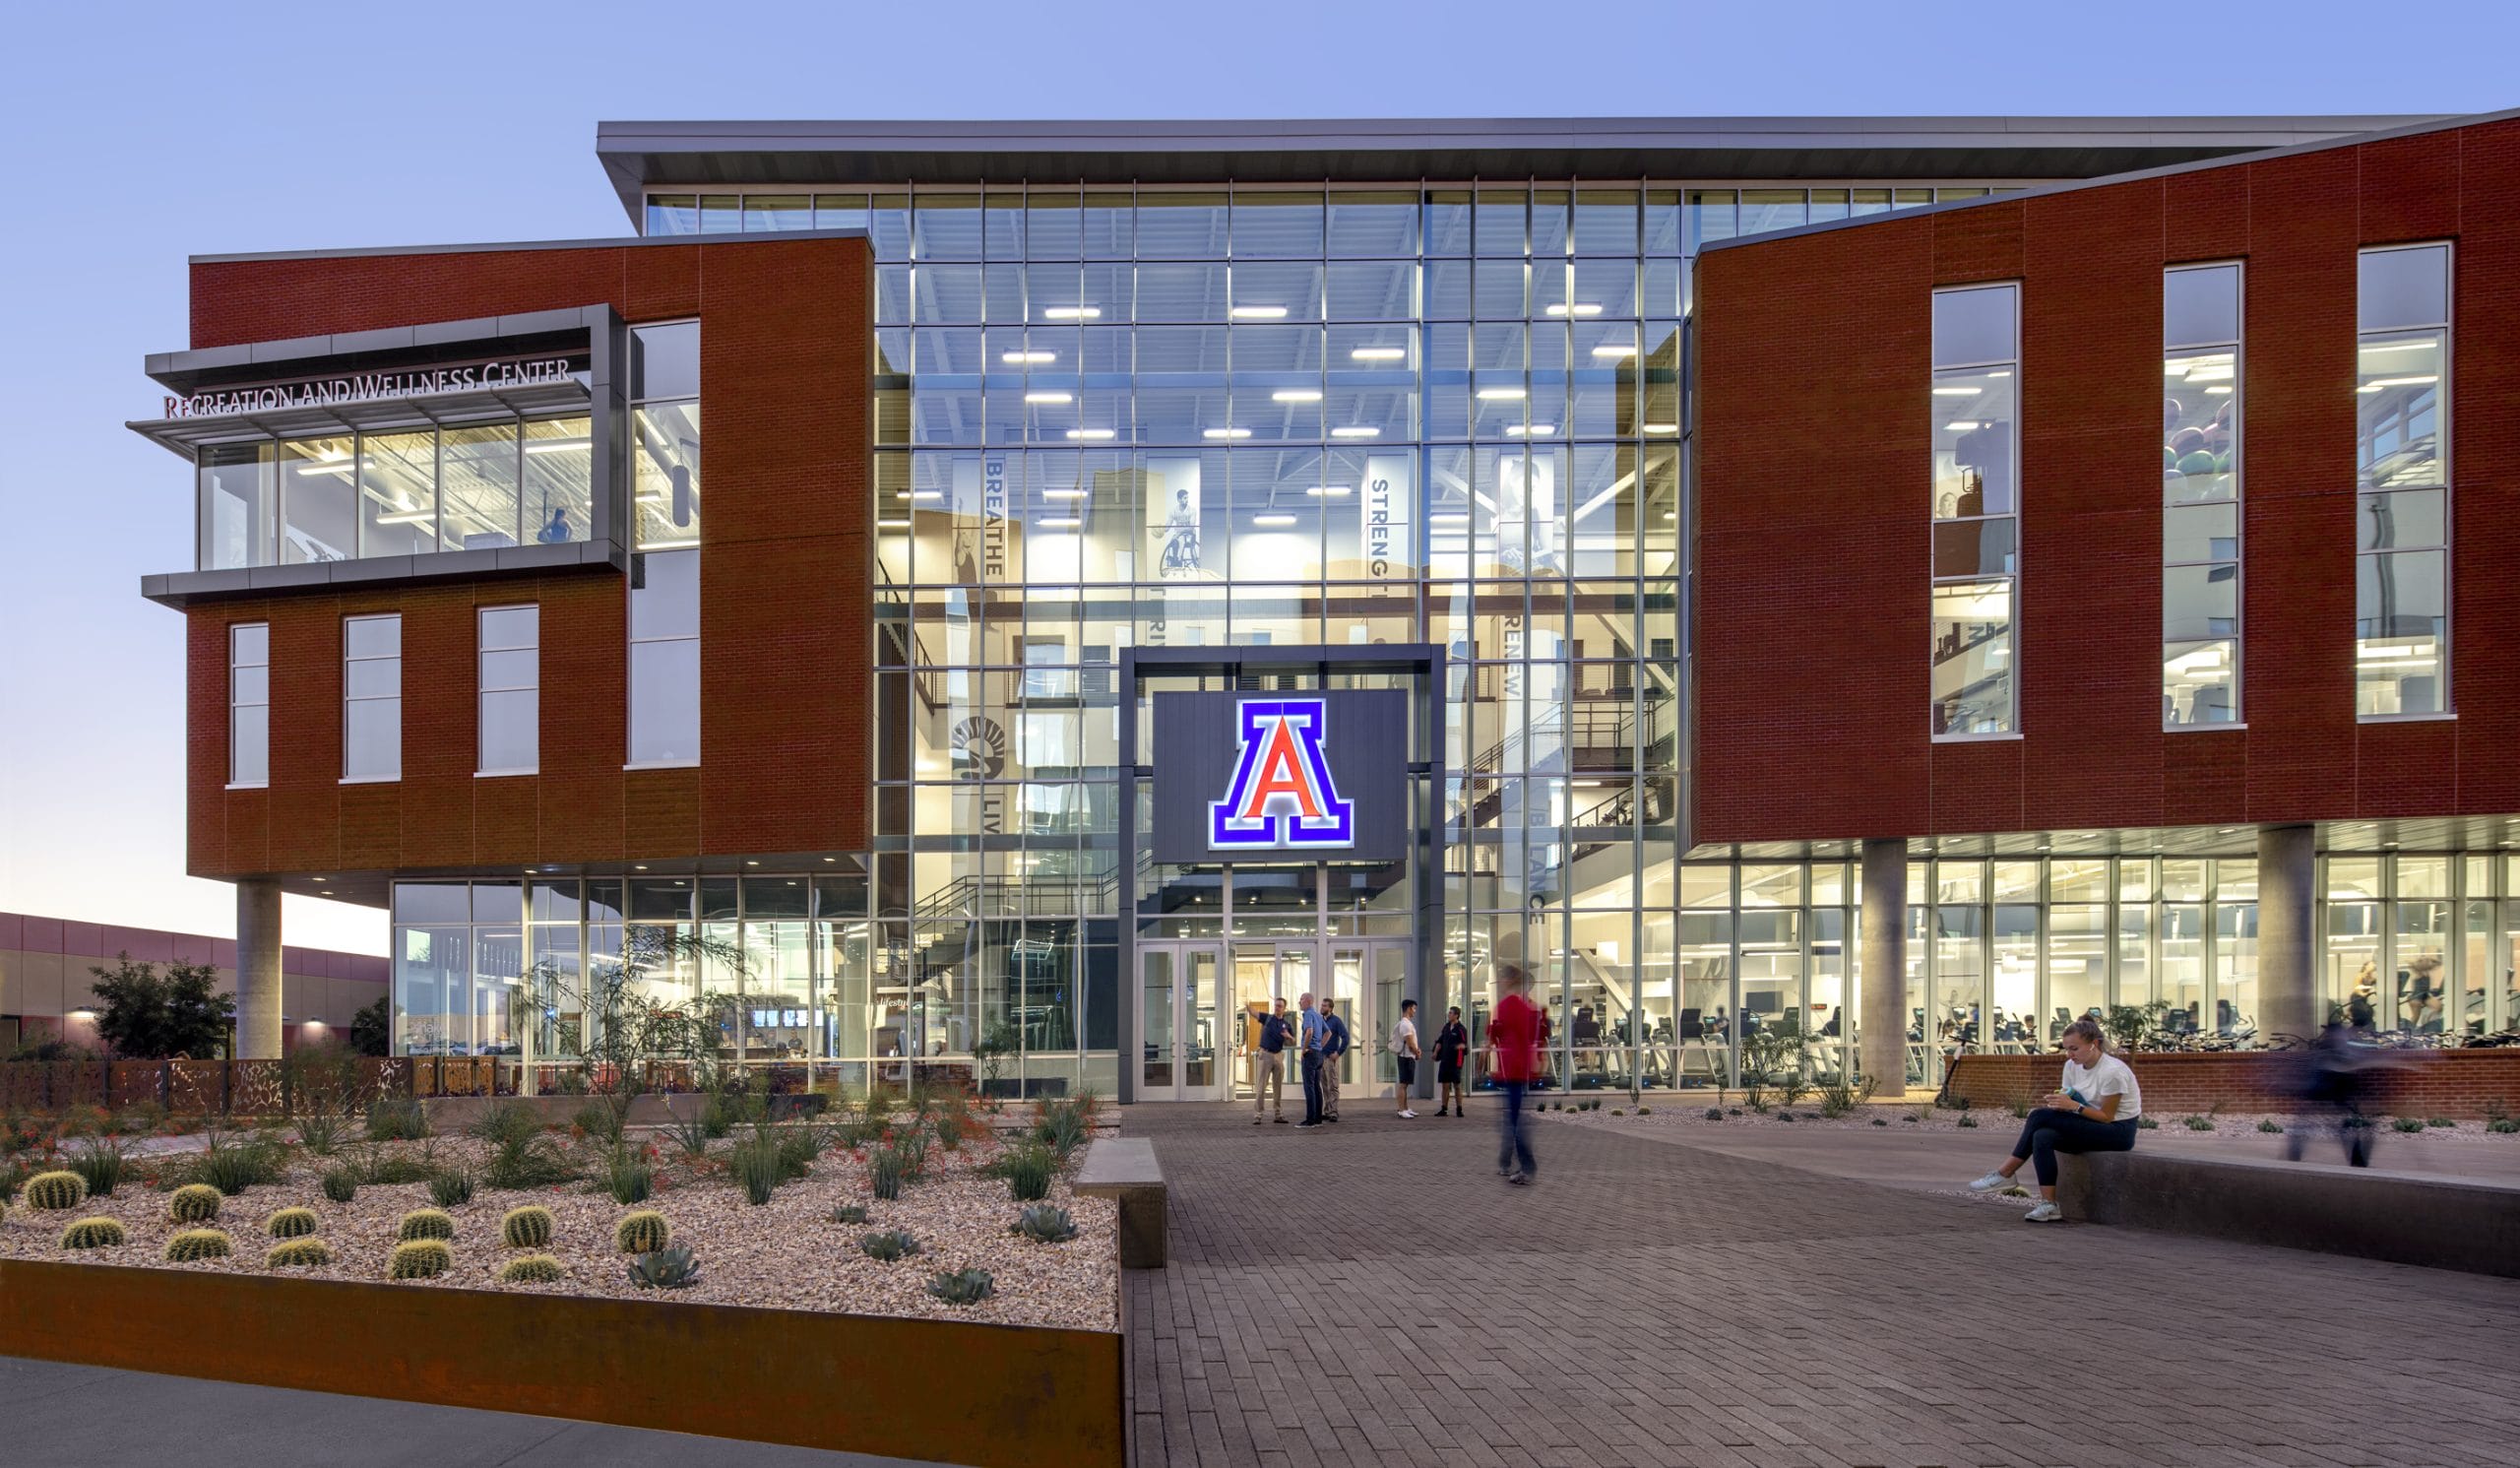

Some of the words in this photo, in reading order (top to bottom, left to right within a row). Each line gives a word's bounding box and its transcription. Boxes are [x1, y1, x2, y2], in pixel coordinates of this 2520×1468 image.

[164, 386, 294, 418] RECREATION
[303, 380, 350, 405] AND
[354, 367, 475, 400] WELLNESS
[482, 359, 570, 388] CENTER
[985, 462, 1003, 576] BREATHE
[1371, 479, 1389, 598] STRENG
[1504, 614, 1521, 696] RENEW
[1208, 698, 1354, 851] A
[1529, 812, 1546, 925] BLANCE
